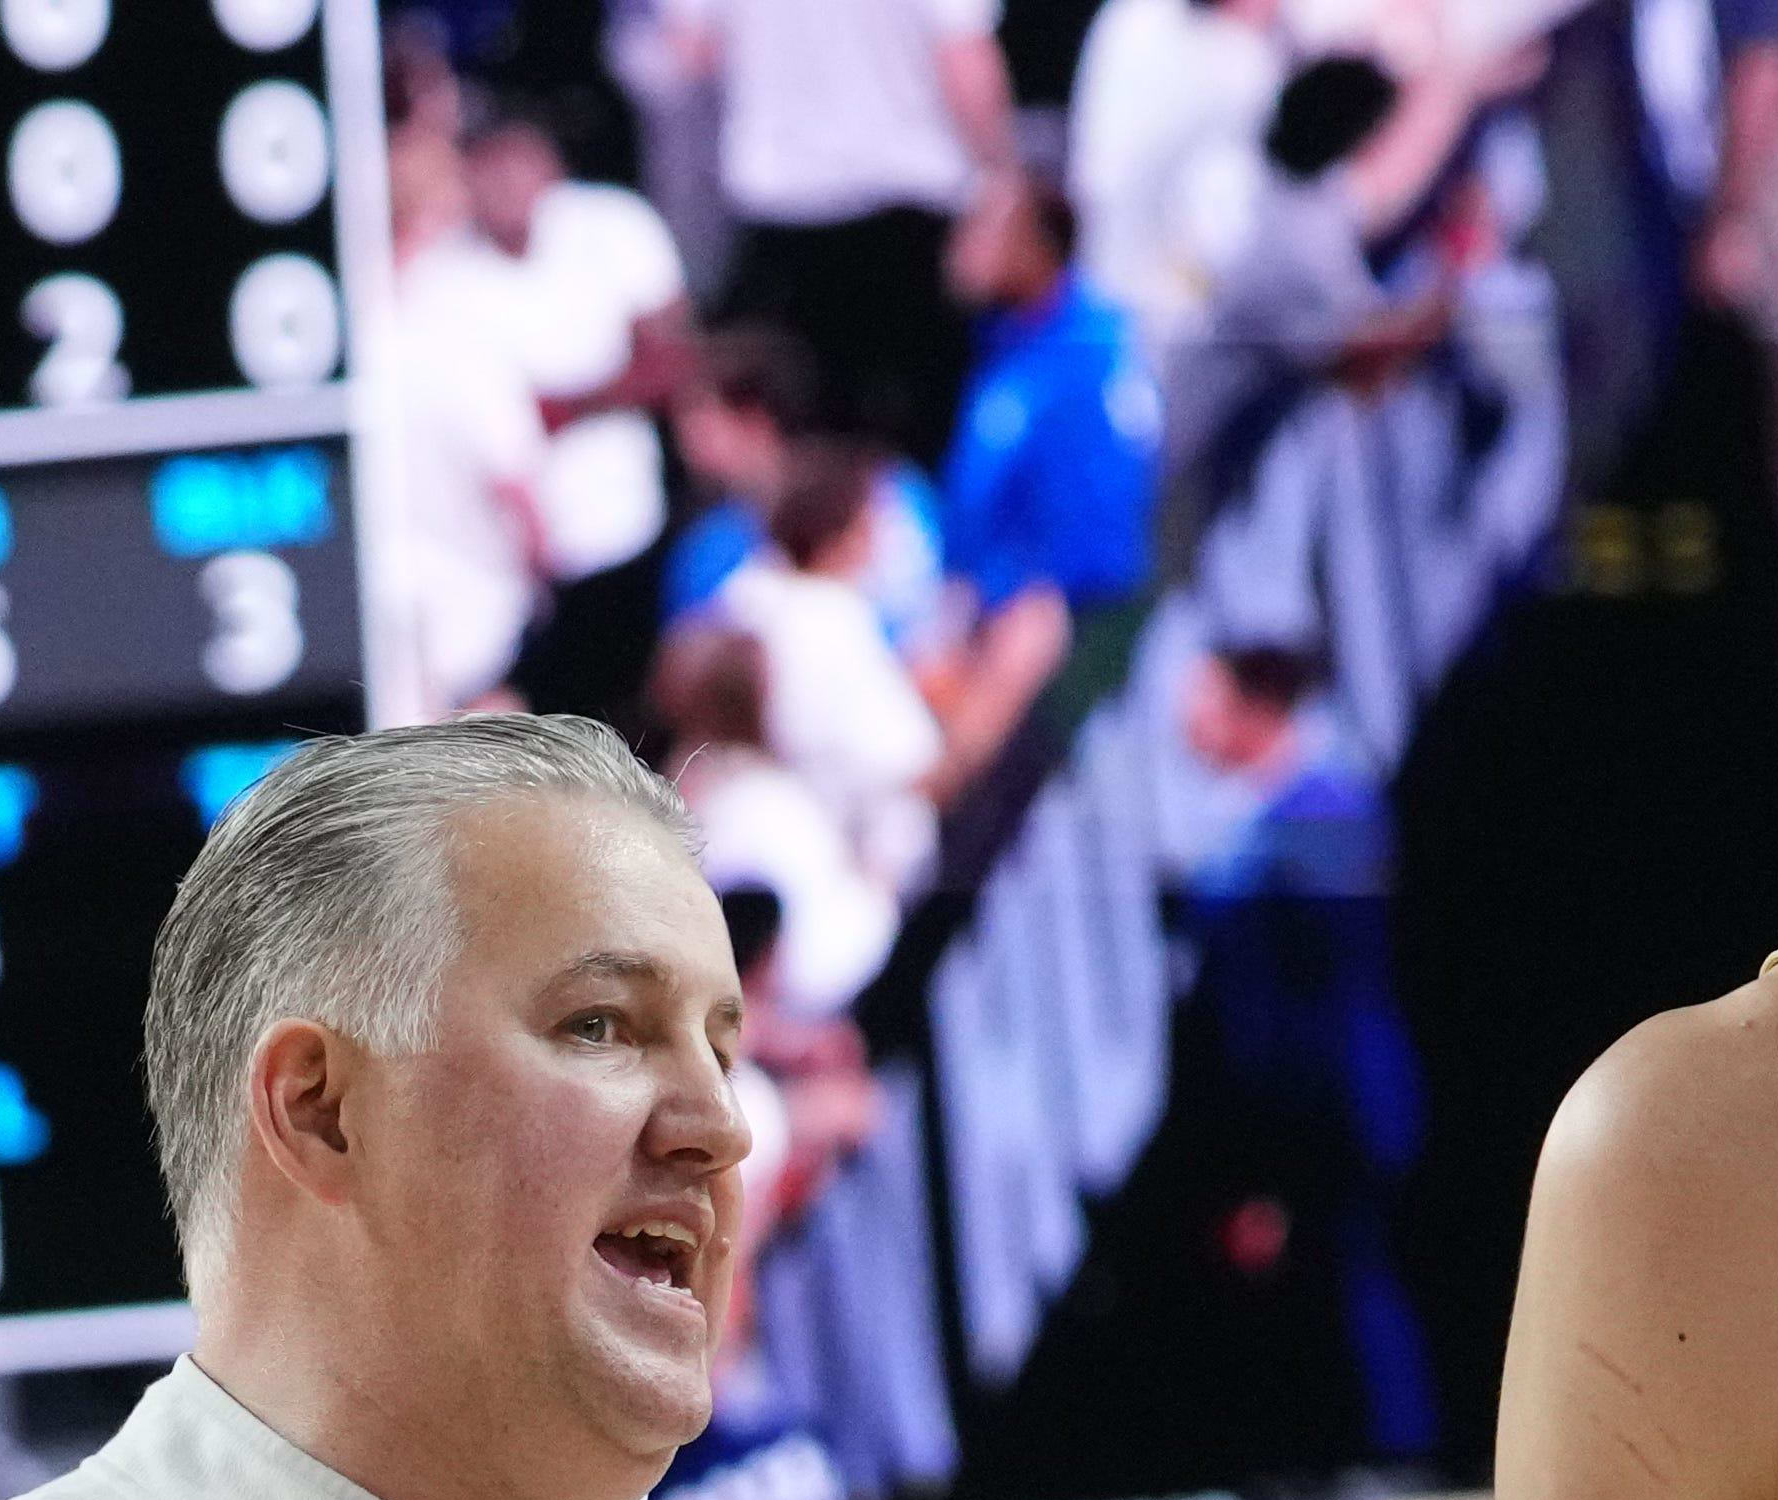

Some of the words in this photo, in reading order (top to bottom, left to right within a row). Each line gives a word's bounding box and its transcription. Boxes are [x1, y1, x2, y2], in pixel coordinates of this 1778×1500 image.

[9, 103, 120, 243] 0
[221, 82, 328, 222] 0
[29, 276, 128, 404] 2
[231, 256, 339, 390] 0
[201, 549, 306, 695] 3
